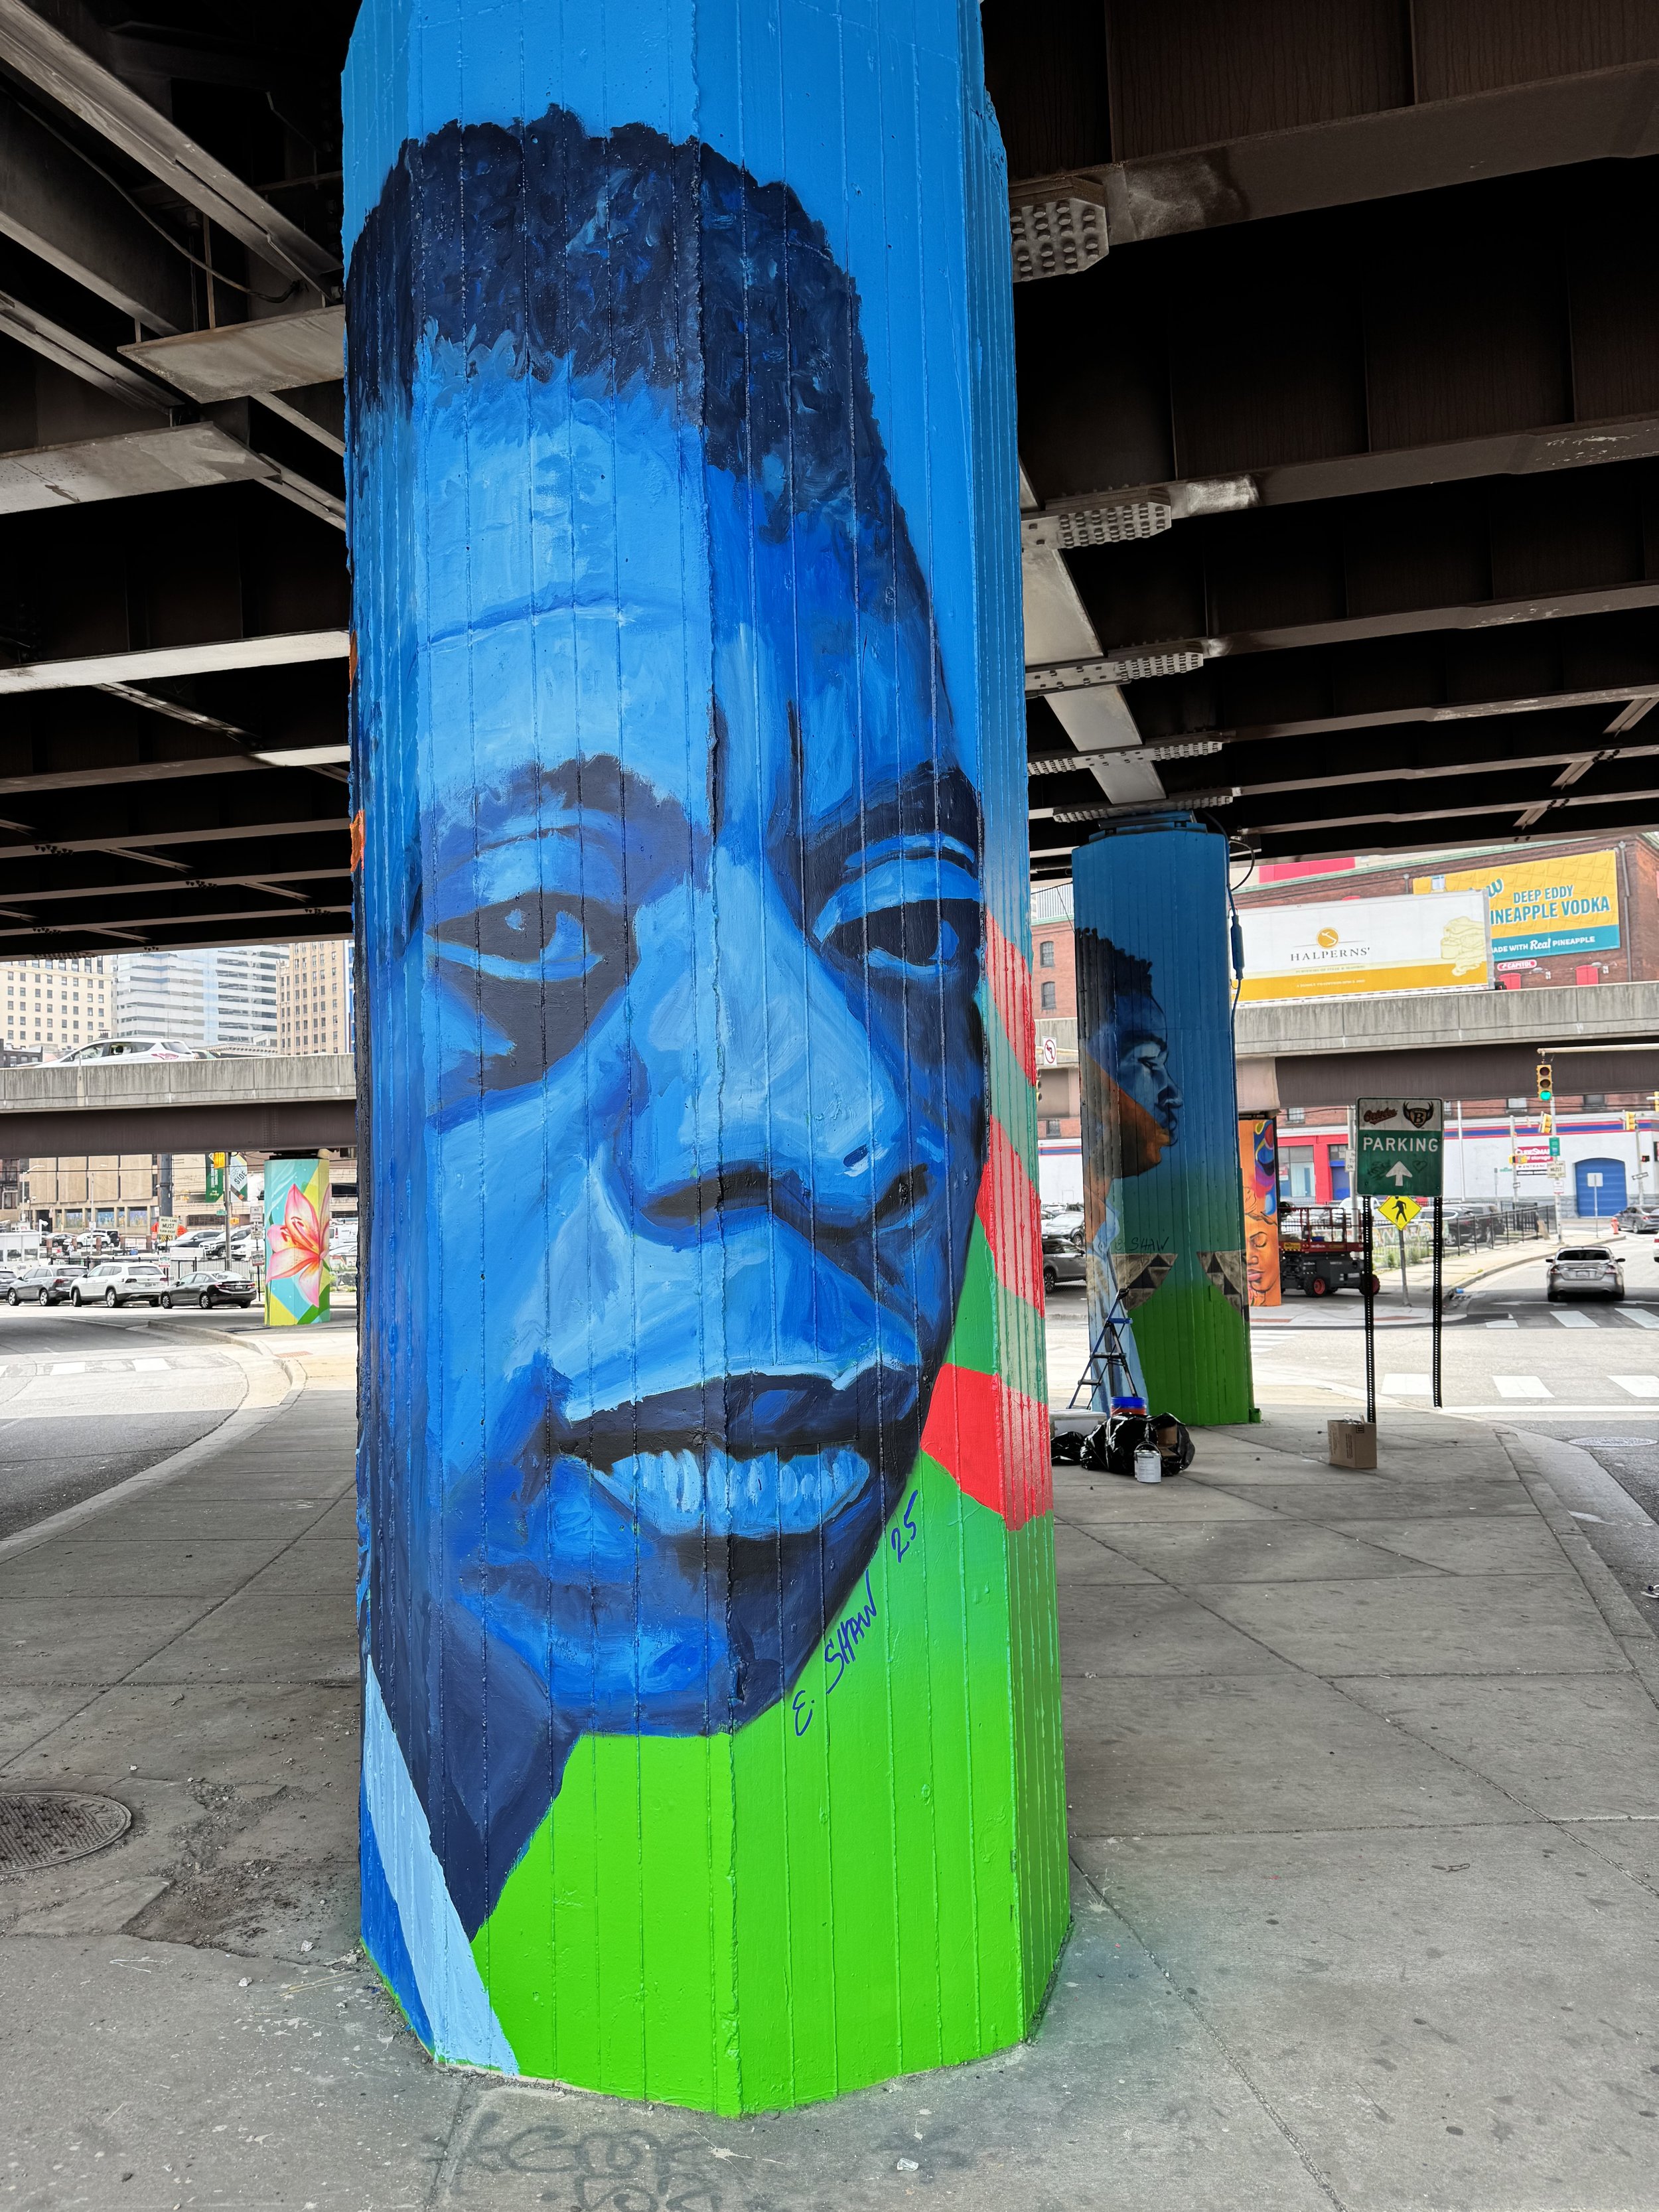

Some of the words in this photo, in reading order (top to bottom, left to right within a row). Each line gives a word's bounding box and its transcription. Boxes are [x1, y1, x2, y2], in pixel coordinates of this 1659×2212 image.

[1513, 889, 1542, 904] DEEP
[1544, 885, 1573, 900] EDDY
[1490, 902, 1558, 925] INEAPPLE
[1561, 896, 1611, 917] VODKA
[1492, 945, 1508, 954] ADE
[1508, 943, 1528, 952] WITH
[1530, 938, 1551, 950] Real
[1552, 936, 1595, 947] PINEAPPLE
[1363, 1137, 1439, 1152] PARKING
[1129, 1236, 1170, 1252] SHAW
[824, 1568, 877, 1694] SHAW
[891, 1489, 918, 1564] 25
